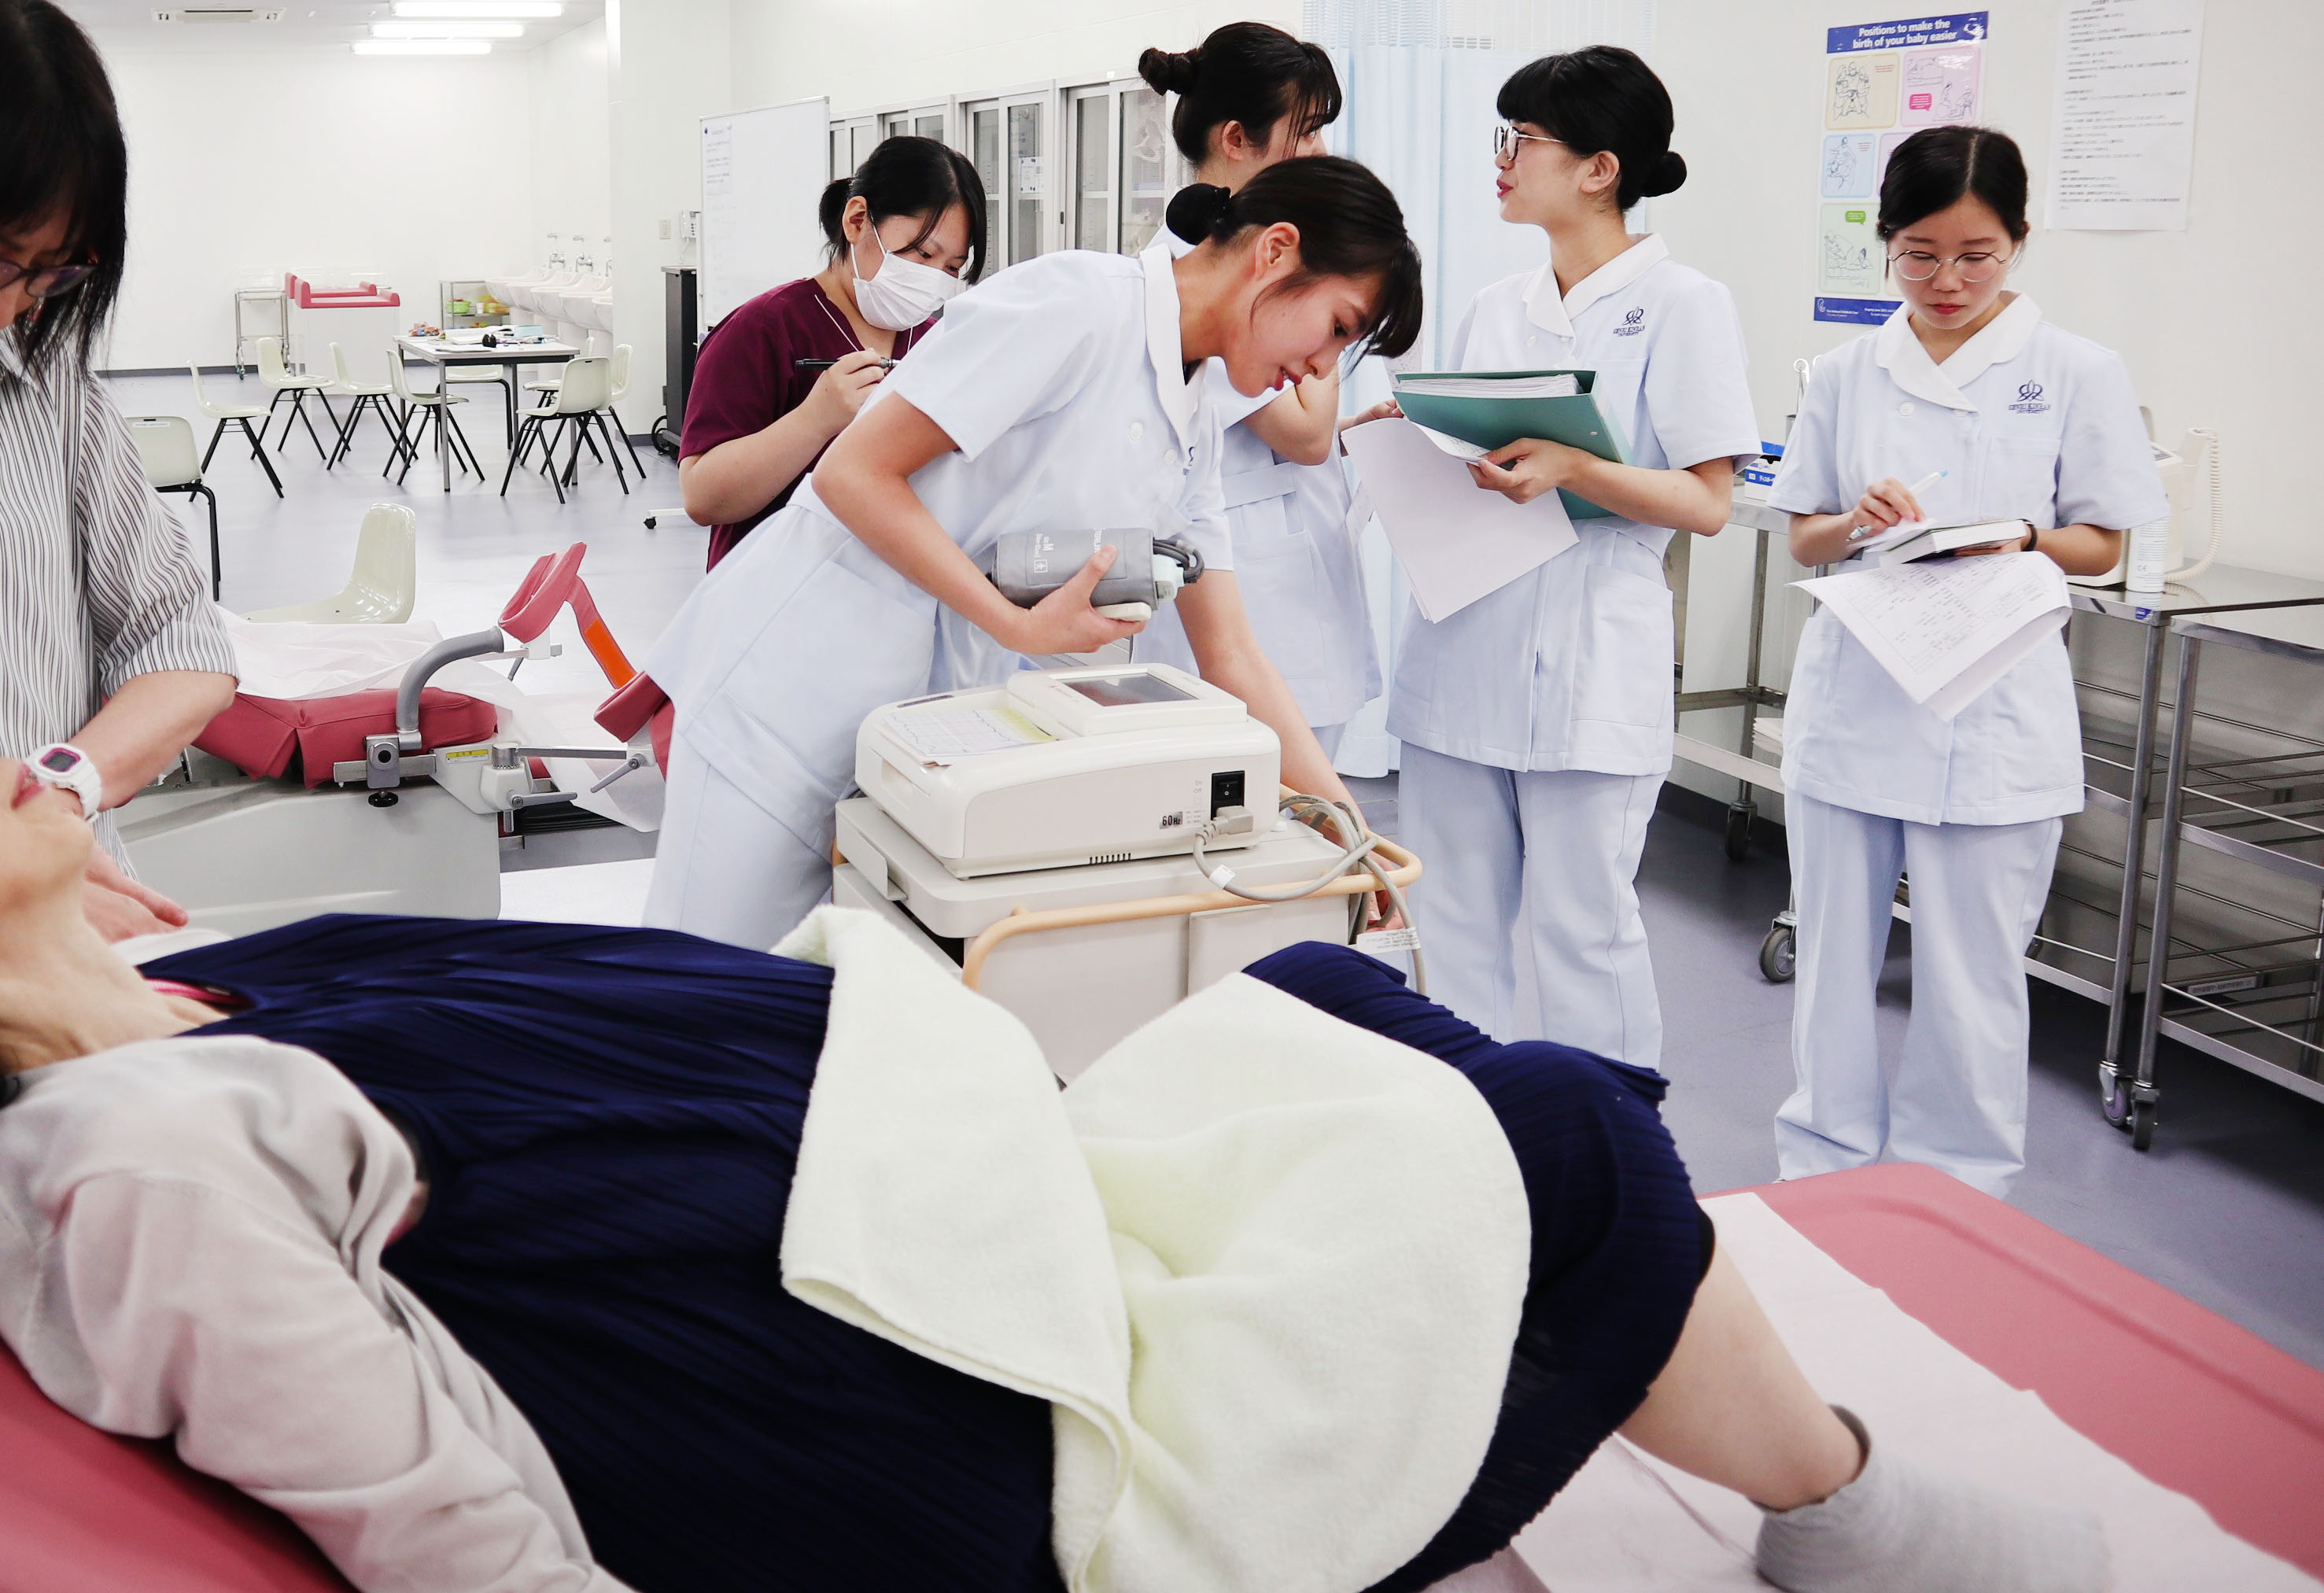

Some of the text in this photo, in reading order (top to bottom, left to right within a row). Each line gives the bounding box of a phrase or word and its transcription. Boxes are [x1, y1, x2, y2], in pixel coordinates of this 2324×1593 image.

[1859, 19, 1950, 37] Positions to make the
[1853, 30, 1957, 49] birth of your baby easier
[1094, 530, 1102, 553] TERUM
